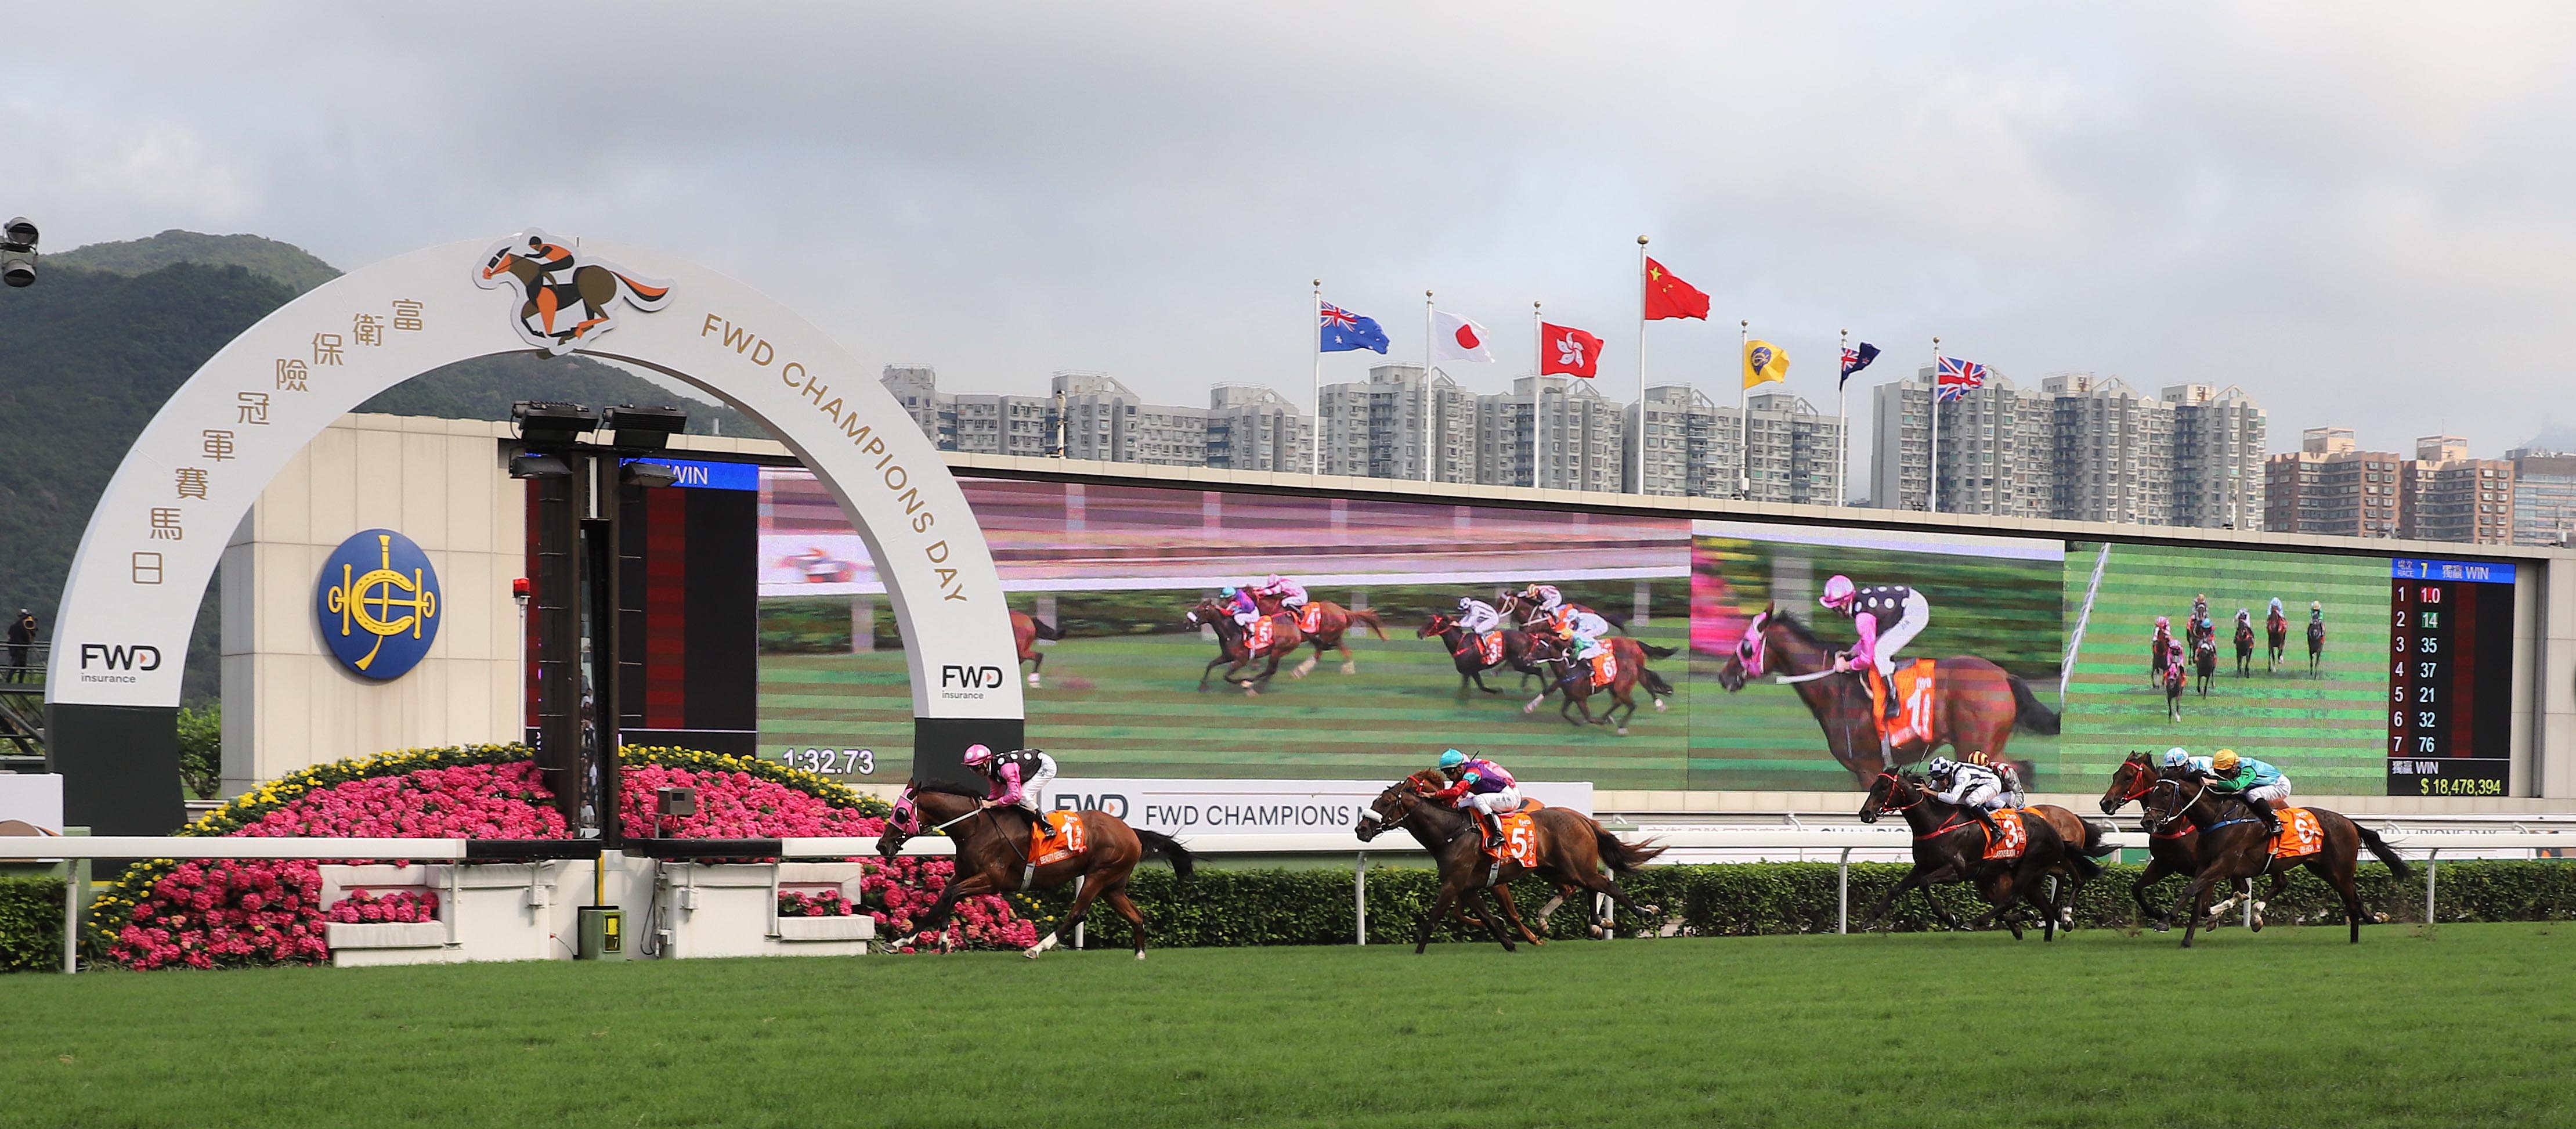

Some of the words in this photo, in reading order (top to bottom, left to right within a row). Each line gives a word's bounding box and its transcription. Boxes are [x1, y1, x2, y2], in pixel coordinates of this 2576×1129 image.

[133, 299, 424, 585] 富衛保險冠軍賽馬日
[702, 313, 775, 367] FWD
[782, 362, 935, 534] CHAMPIONS
[925, 539, 968, 602] DAY
[2420, 562, 2429, 578] 7
[2465, 565, 2490, 580] WIN
[2398, 586, 2405, 602] 1
[2421, 587, 2441, 604] 1.0
[2396, 611, 2405, 627] 2
[2423, 612, 2438, 628] 14
[2396, 636, 2405, 652] 3
[2421, 637, 2437, 653] 35
[81, 643, 161, 672] FWD
[81, 673, 136, 684] insurance
[942, 665, 1003, 688] FWD
[2395, 661, 2404, 677] 4
[2420, 662, 2437, 678] 37
[942, 690, 984, 700] insurance
[2394, 686, 2404, 702] 5
[2419, 687, 2435, 702] 21
[1906, 688, 1921, 734] 1
[2394, 711, 2403, 727] 6
[2419, 712, 2436, 727] 32
[2394, 736, 2402, 752] 7
[2419, 737, 2435, 752] 76
[783, 748, 875, 774] 1:32.73
[2415, 761, 2439, 775] WIN
[2420, 777, 2429, 795] $
[2433, 778, 2501, 796] 18,478,394
[1146, 805, 1198, 825] FWD
[1206, 805, 1350, 826] CHAMPIONS
[1061, 821, 1074, 851] 1
[2003, 819, 2018, 848] 3
[2295, 818, 2315, 844] 6
[1510, 827, 1527, 859] 5
